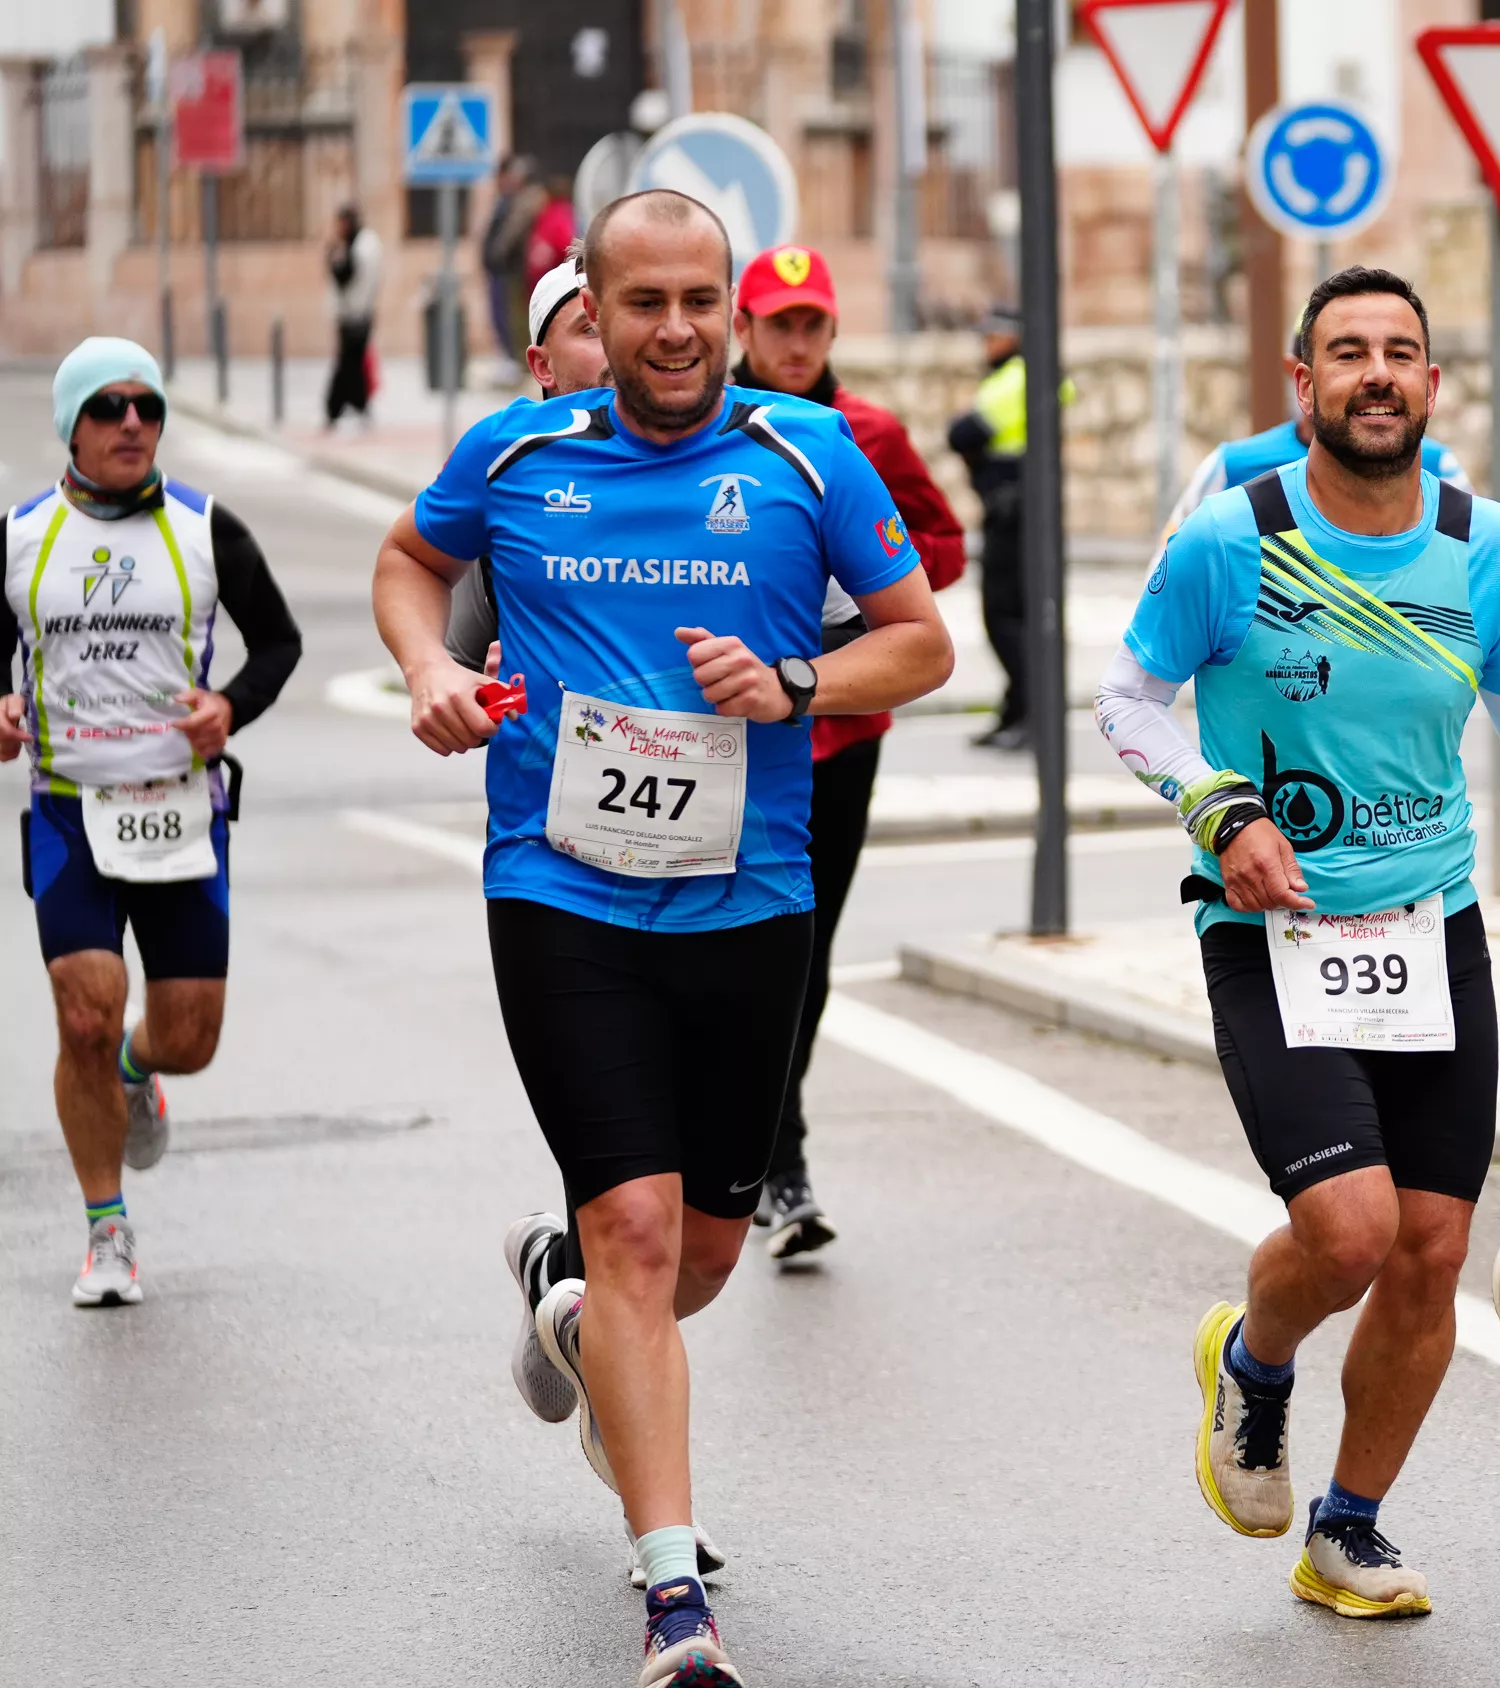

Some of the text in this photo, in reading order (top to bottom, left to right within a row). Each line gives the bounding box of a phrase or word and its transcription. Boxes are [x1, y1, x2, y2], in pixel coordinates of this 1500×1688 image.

[541, 555, 751, 587] TROTASIERRA
[44, 612, 176, 635] VETE-RUNNERS
[79, 640, 140, 662] JEREZ
[654, 726, 700, 743] MARATÓN
[629, 736, 687, 761] LUCENA
[597, 767, 697, 821] 247
[1351, 792, 1444, 830] bética
[117, 810, 182, 842] 868
[585, 823, 703, 843] LUIS FRANCISCO DELGADO GONZÁLEZ
[1342, 821, 1448, 847] de lubricantes
[1360, 911, 1400, 925] MARATÓN
[1340, 924, 1392, 939] LUCENA
[1319, 953, 1409, 996] 939
[1284, 1141, 1354, 1175] TROTASIERRA
[1213, 1372, 1226, 1433] HOKA
